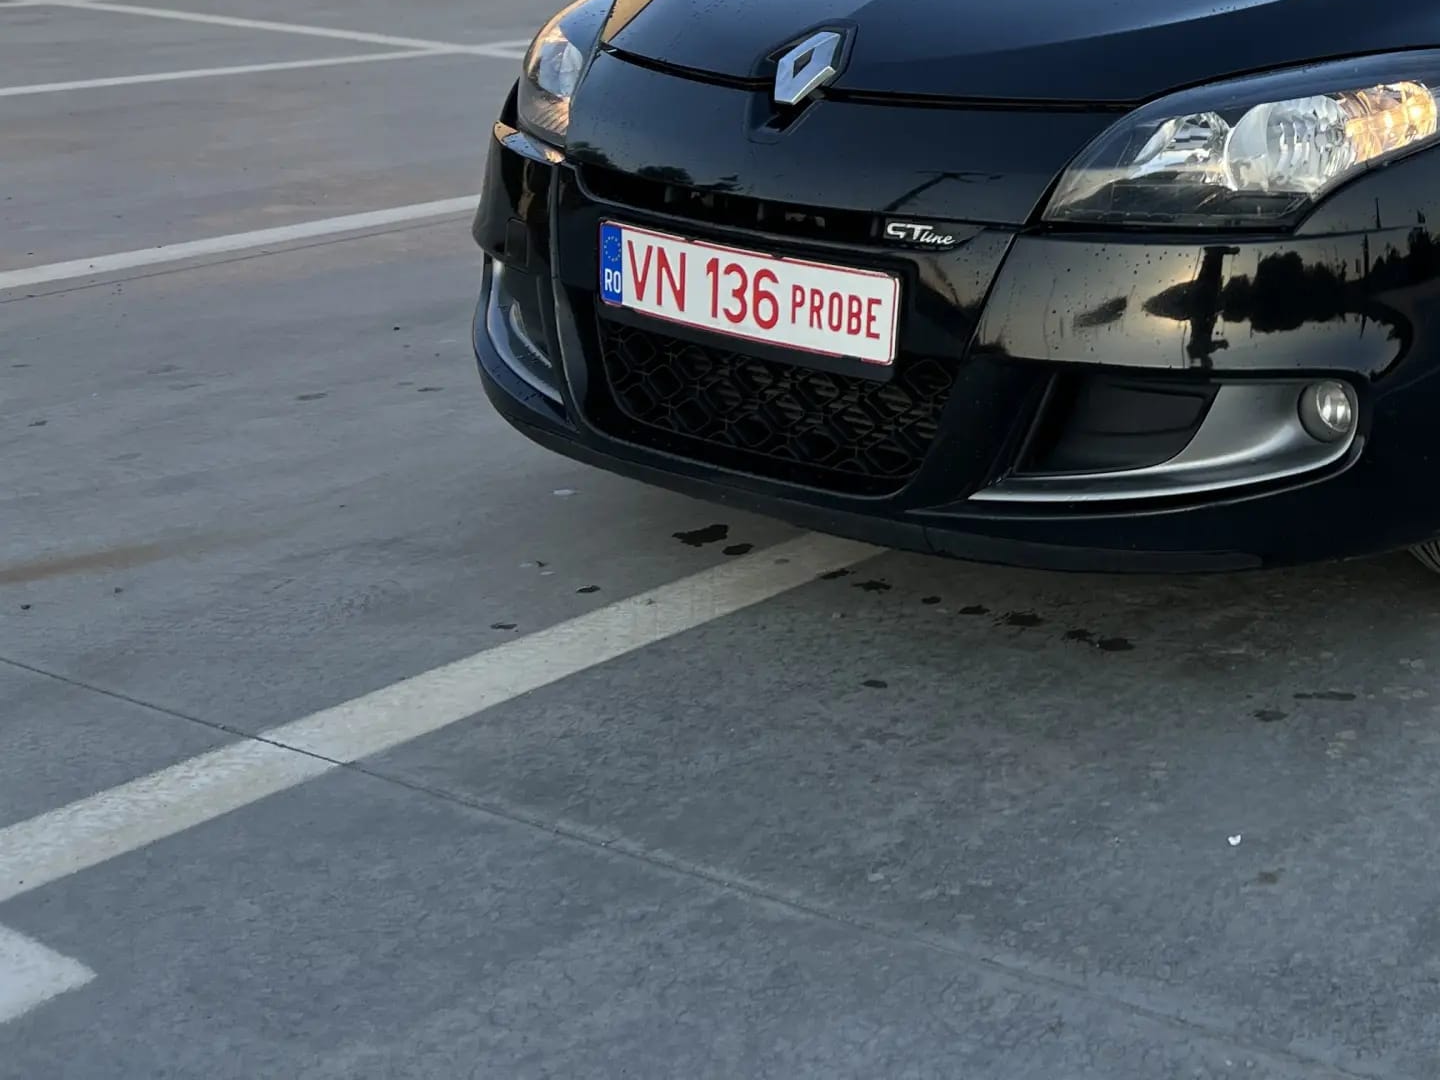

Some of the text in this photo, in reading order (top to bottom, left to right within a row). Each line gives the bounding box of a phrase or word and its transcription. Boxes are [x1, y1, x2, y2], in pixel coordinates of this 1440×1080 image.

[604, 268, 621, 293] RO
[627, 240, 882, 339] VN 136 PROBE
